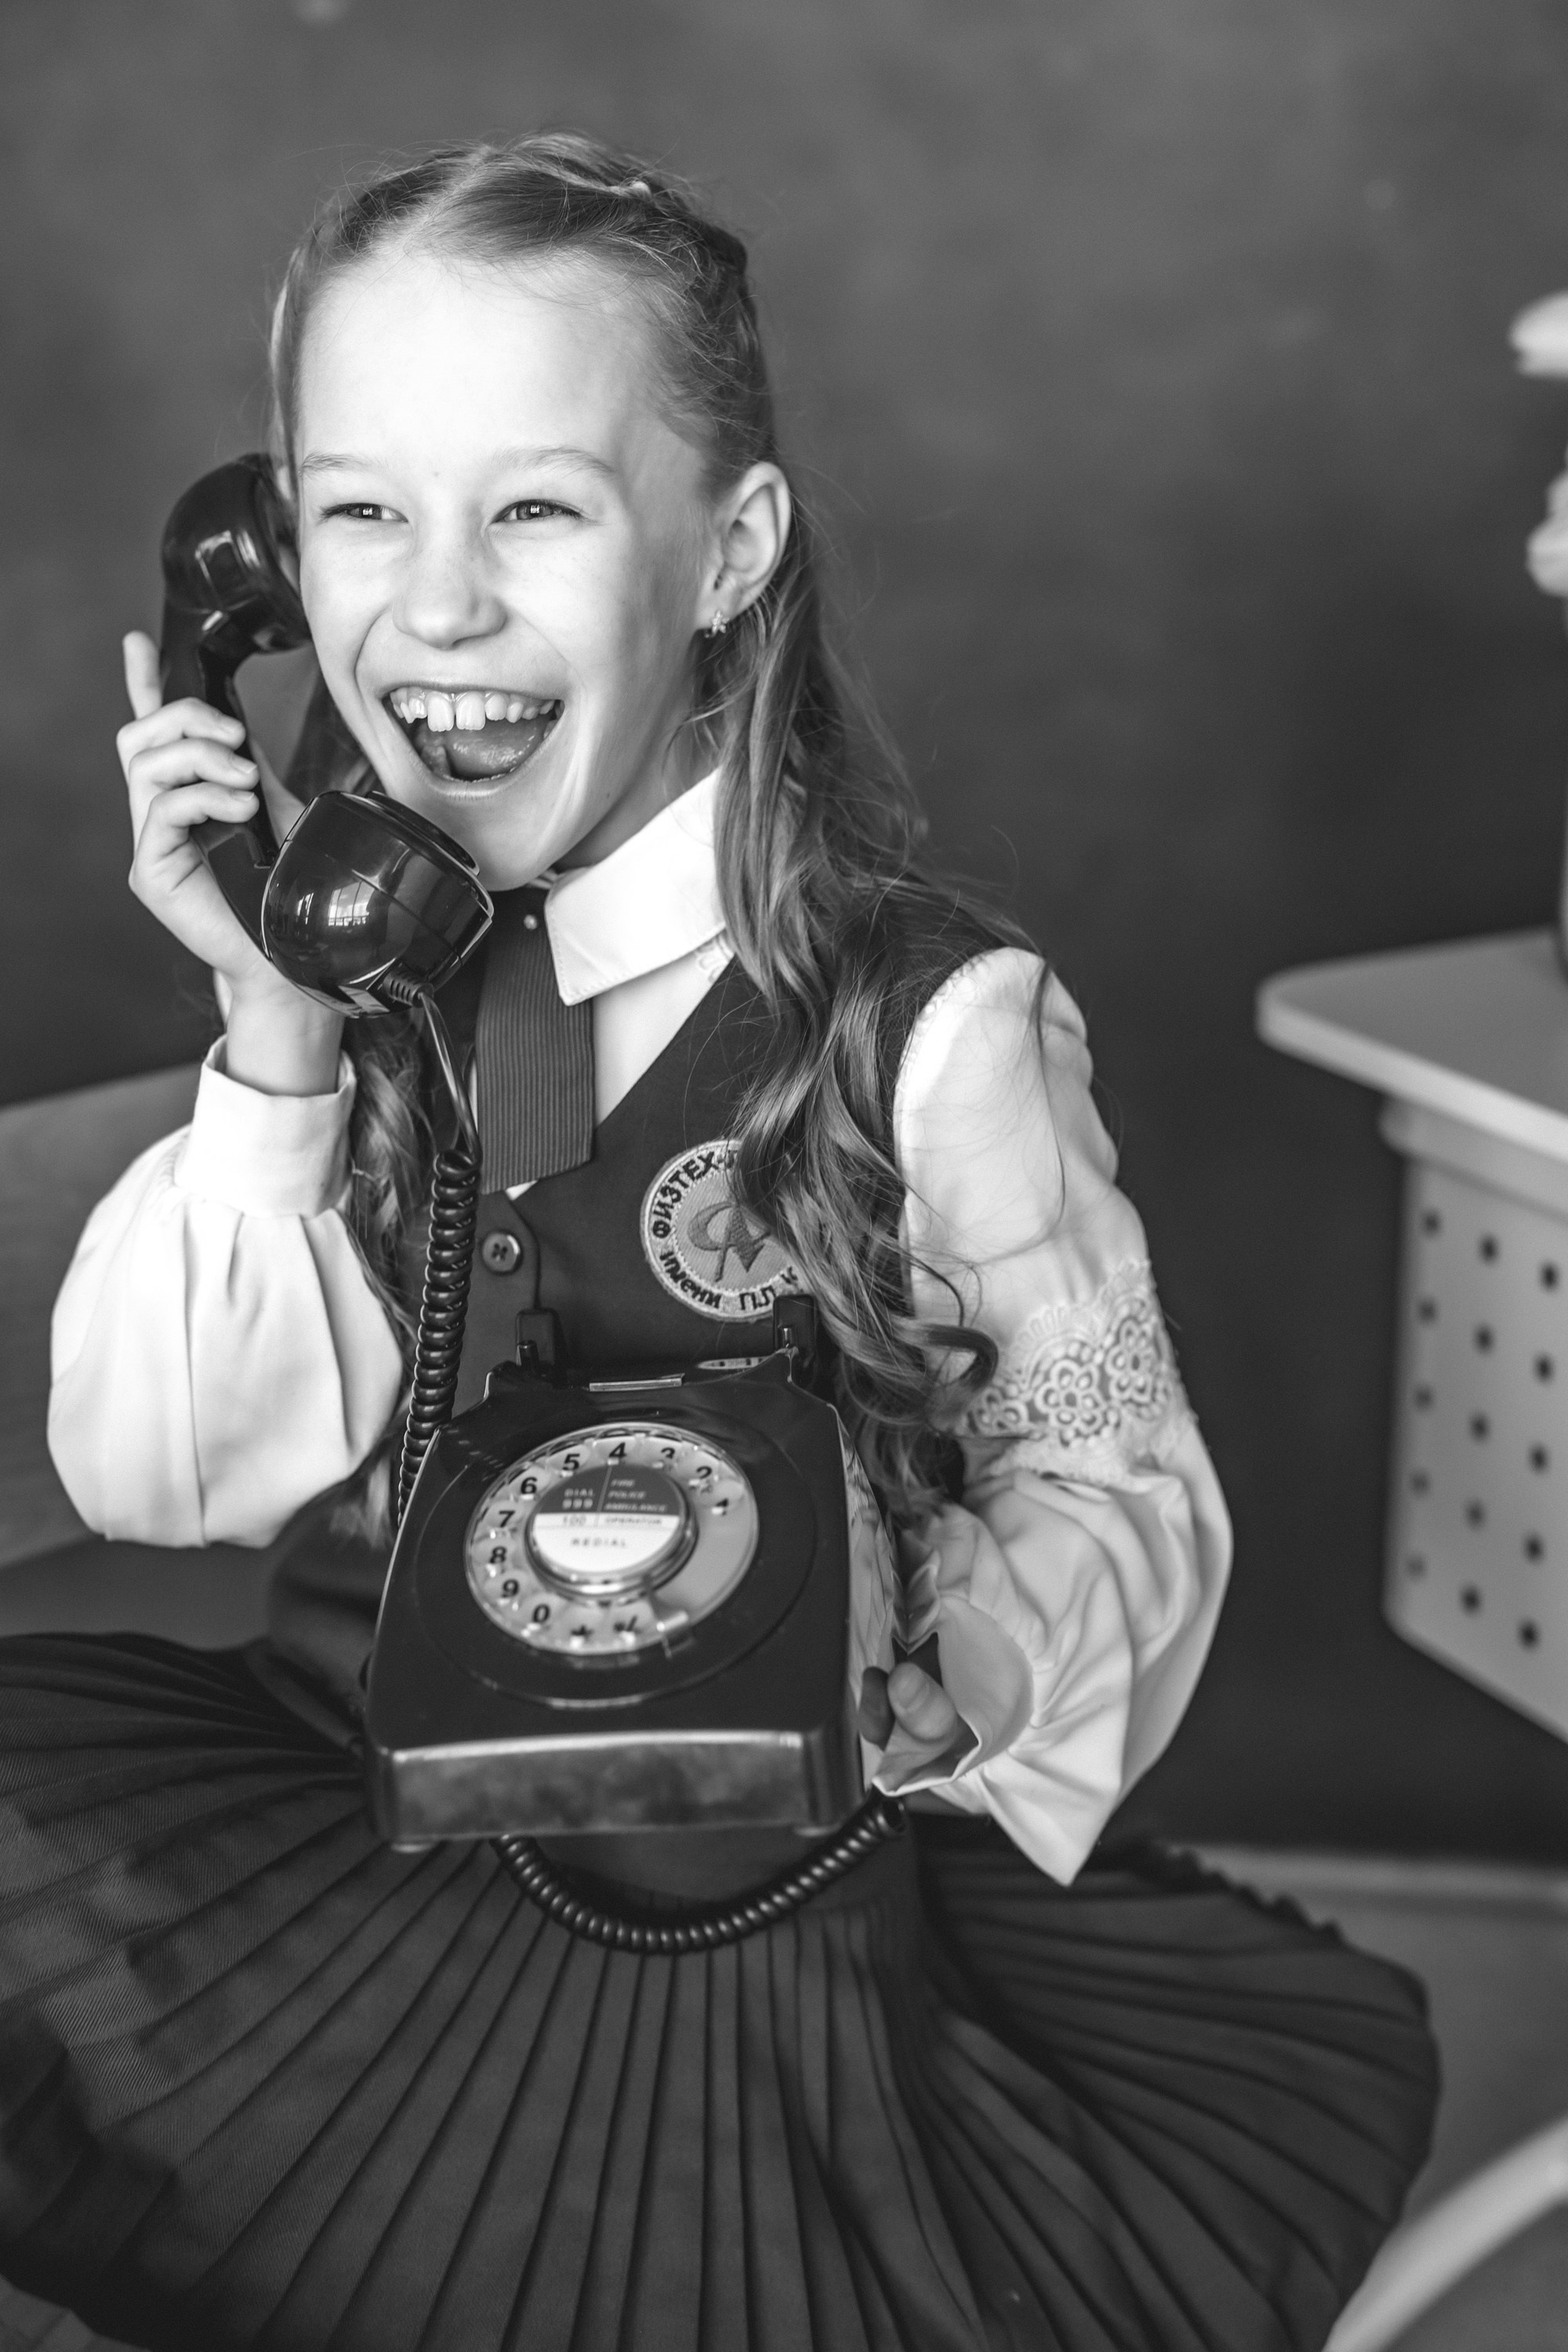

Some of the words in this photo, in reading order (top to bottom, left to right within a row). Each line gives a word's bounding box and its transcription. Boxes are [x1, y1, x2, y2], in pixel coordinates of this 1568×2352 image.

[608, 1442, 627, 1459] 4
[563, 1454, 580, 1472] 5
[521, 1477, 537, 1494] 6
[564, 1488, 593, 1497] DIAL
[499, 1510, 515, 1528] 7
[489, 1546, 507, 1564] 8
[503, 1579, 520, 1598] 9
[532, 1604, 550, 1623] 0
